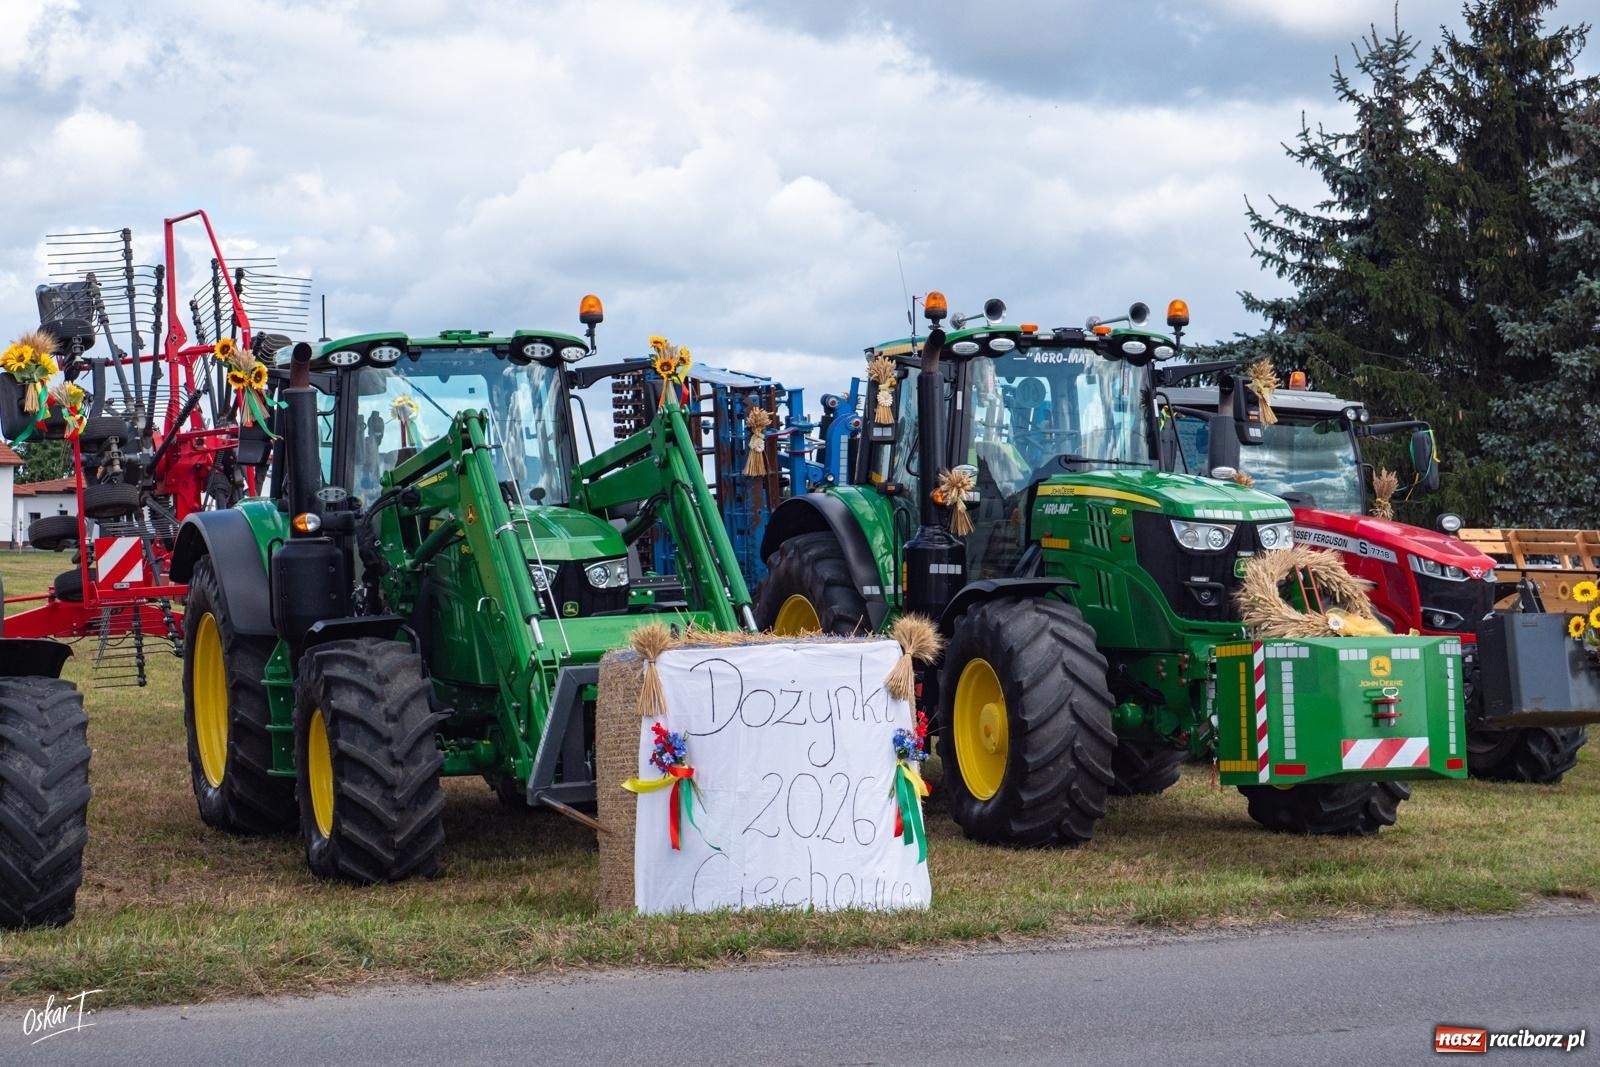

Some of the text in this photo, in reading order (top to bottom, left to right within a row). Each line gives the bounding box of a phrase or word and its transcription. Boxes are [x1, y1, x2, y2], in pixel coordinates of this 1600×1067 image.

[1313, 533, 1348, 548] FERGUSON
[1359, 541, 1368, 555] S
[1379, 679, 1403, 687] DEERE
[686, 655, 894, 767] Dożynki
